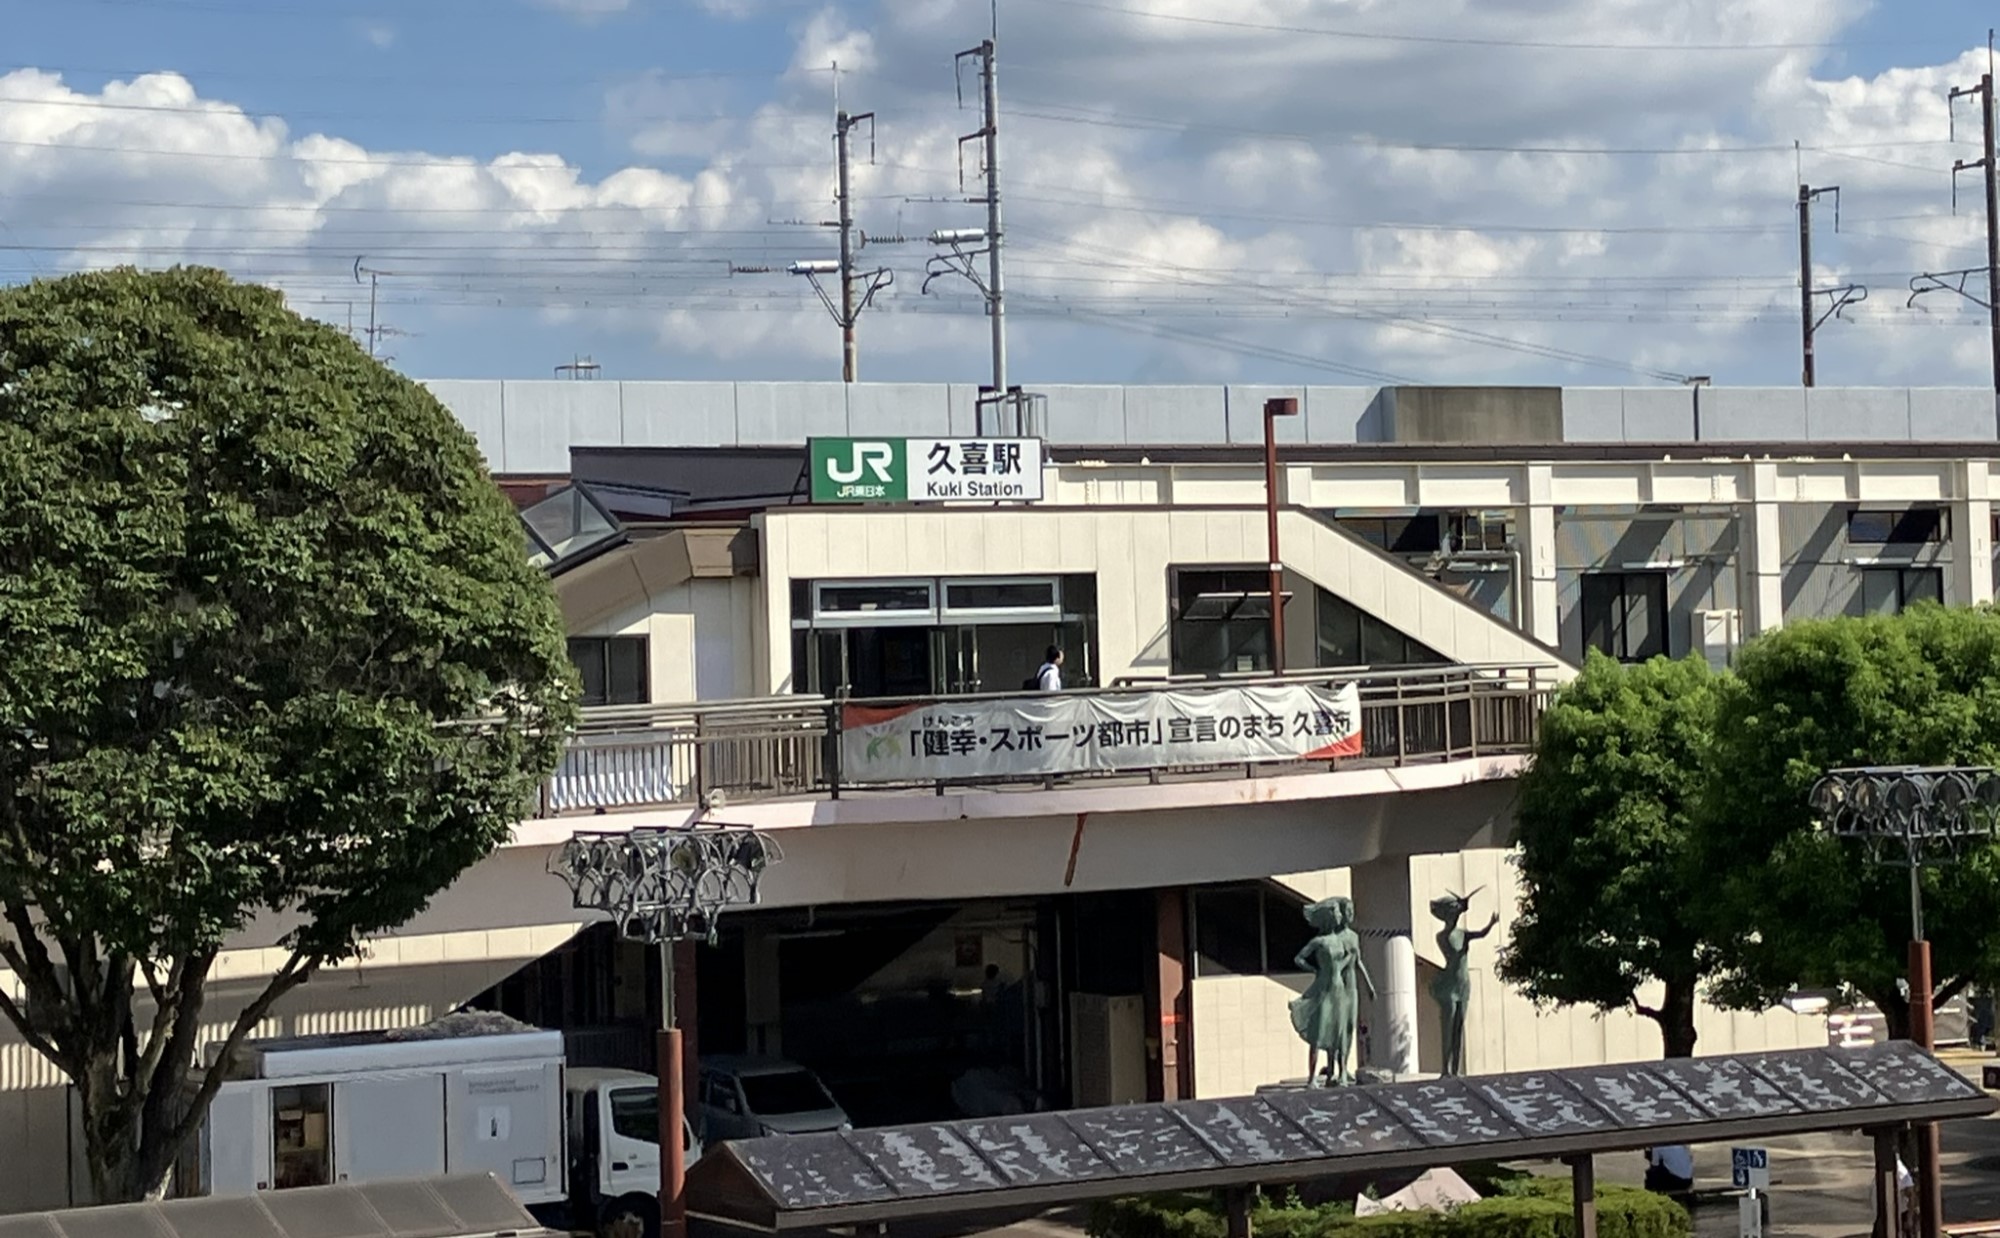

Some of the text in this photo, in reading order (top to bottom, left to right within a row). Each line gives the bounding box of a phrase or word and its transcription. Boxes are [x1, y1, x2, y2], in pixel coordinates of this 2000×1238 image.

[827, 442, 893, 483] JR
[927, 442, 1022, 476] 久喜駅
[836, 484, 886, 498] JR東日本
[927, 481, 1023, 497] Kuki Station
